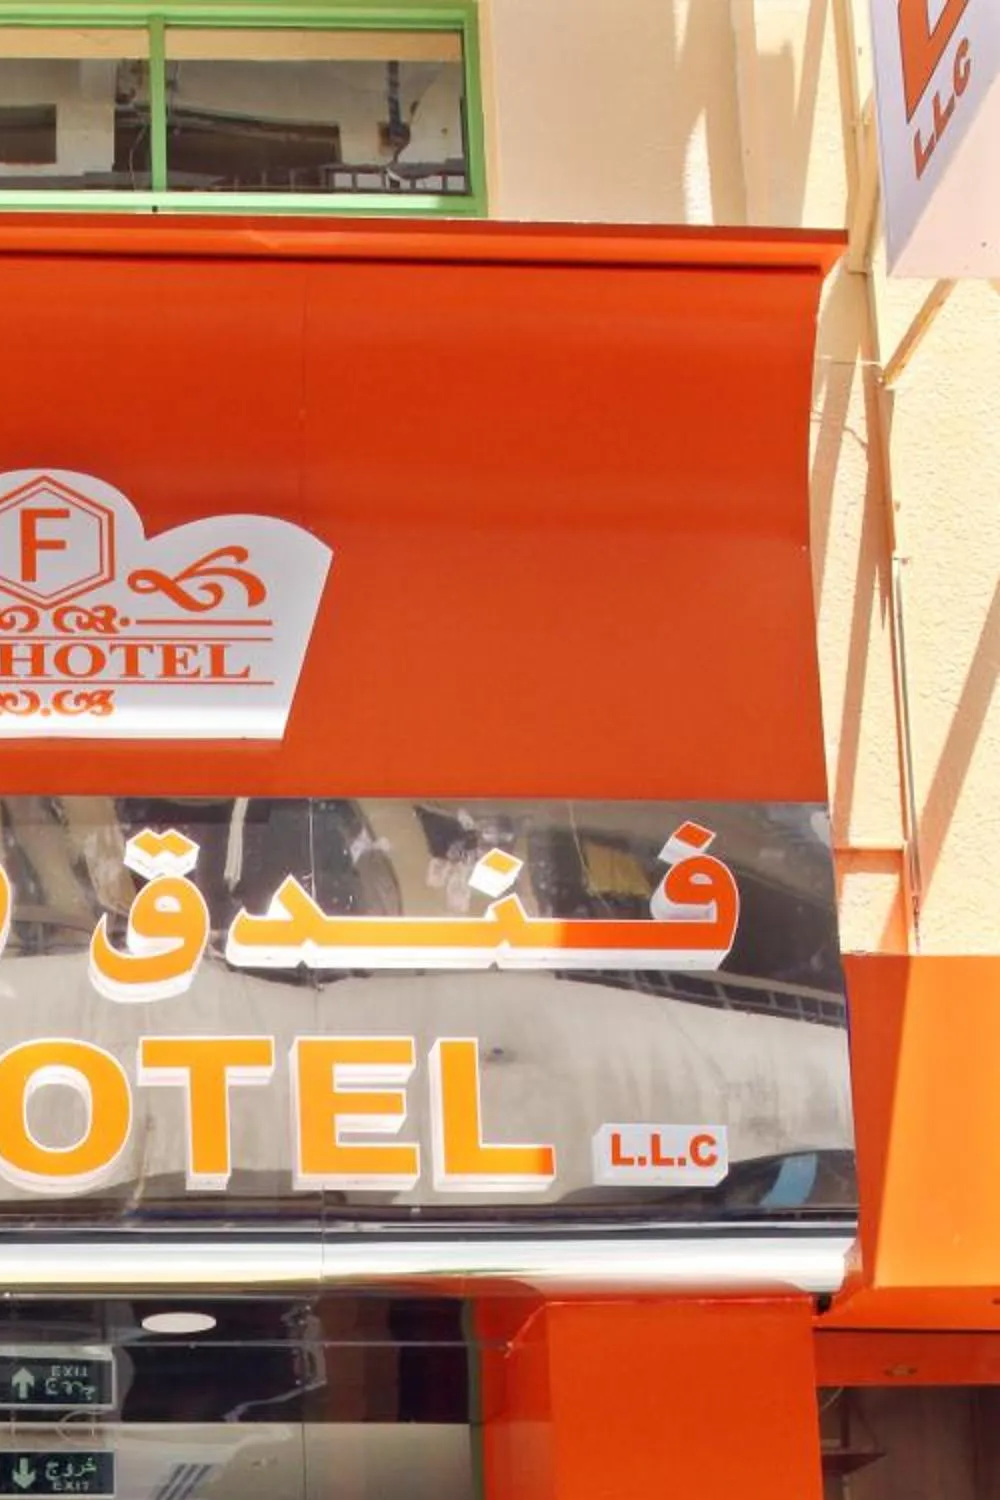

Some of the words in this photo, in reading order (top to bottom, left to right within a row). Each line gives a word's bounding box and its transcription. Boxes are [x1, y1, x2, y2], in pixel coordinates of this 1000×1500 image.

[18, 507, 71, 583] F
[89, 820, 740, 1003] فندق
[609, 1131, 718, 1167] L.L.C
[45, 1457, 97, 1481] خروج
[52, 1481, 90, 1491] EXIT
